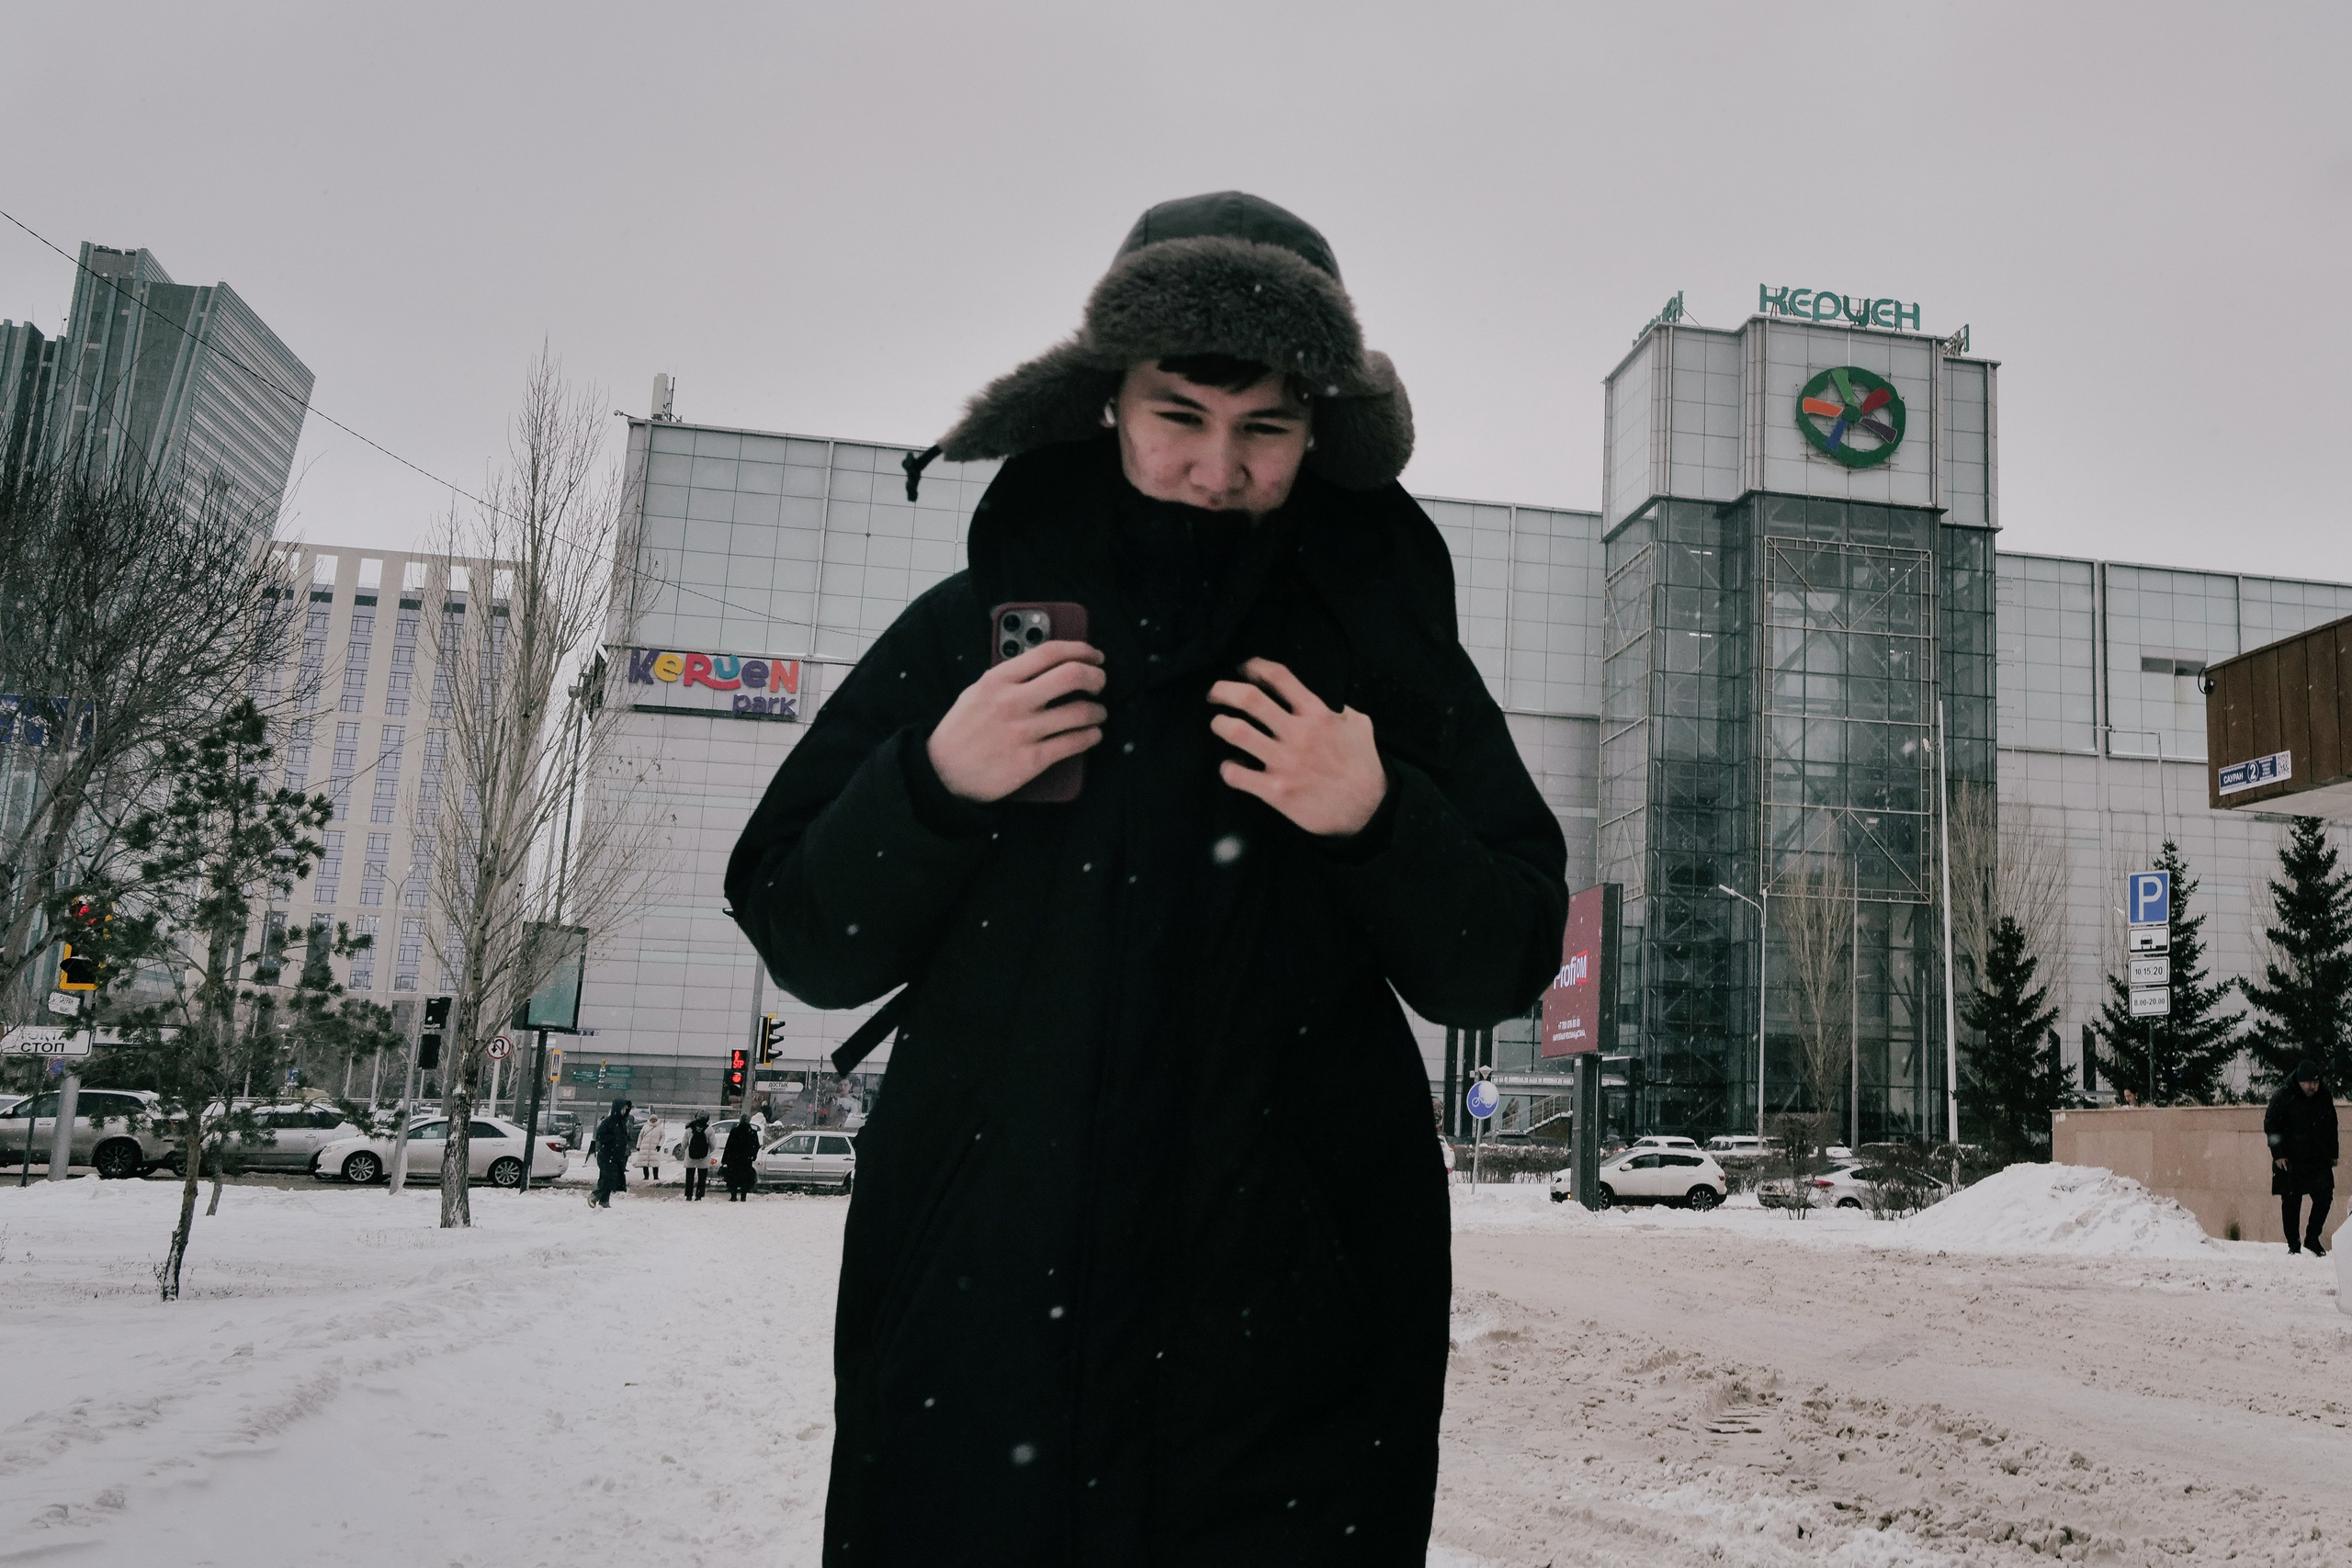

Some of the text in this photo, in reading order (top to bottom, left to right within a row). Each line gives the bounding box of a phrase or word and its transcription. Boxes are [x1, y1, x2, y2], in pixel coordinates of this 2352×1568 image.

[732, 694, 797, 716] park
[2250, 763, 2256, 780] 2
[2223, 772, 2244, 784] САУРАН
[2138, 875, 2163, 921] P
[2154, 966, 2163, 975] 20
[2133, 998, 2165, 1007] 8.00-20.00
[20, 1043, 64, 1053] СТОП
